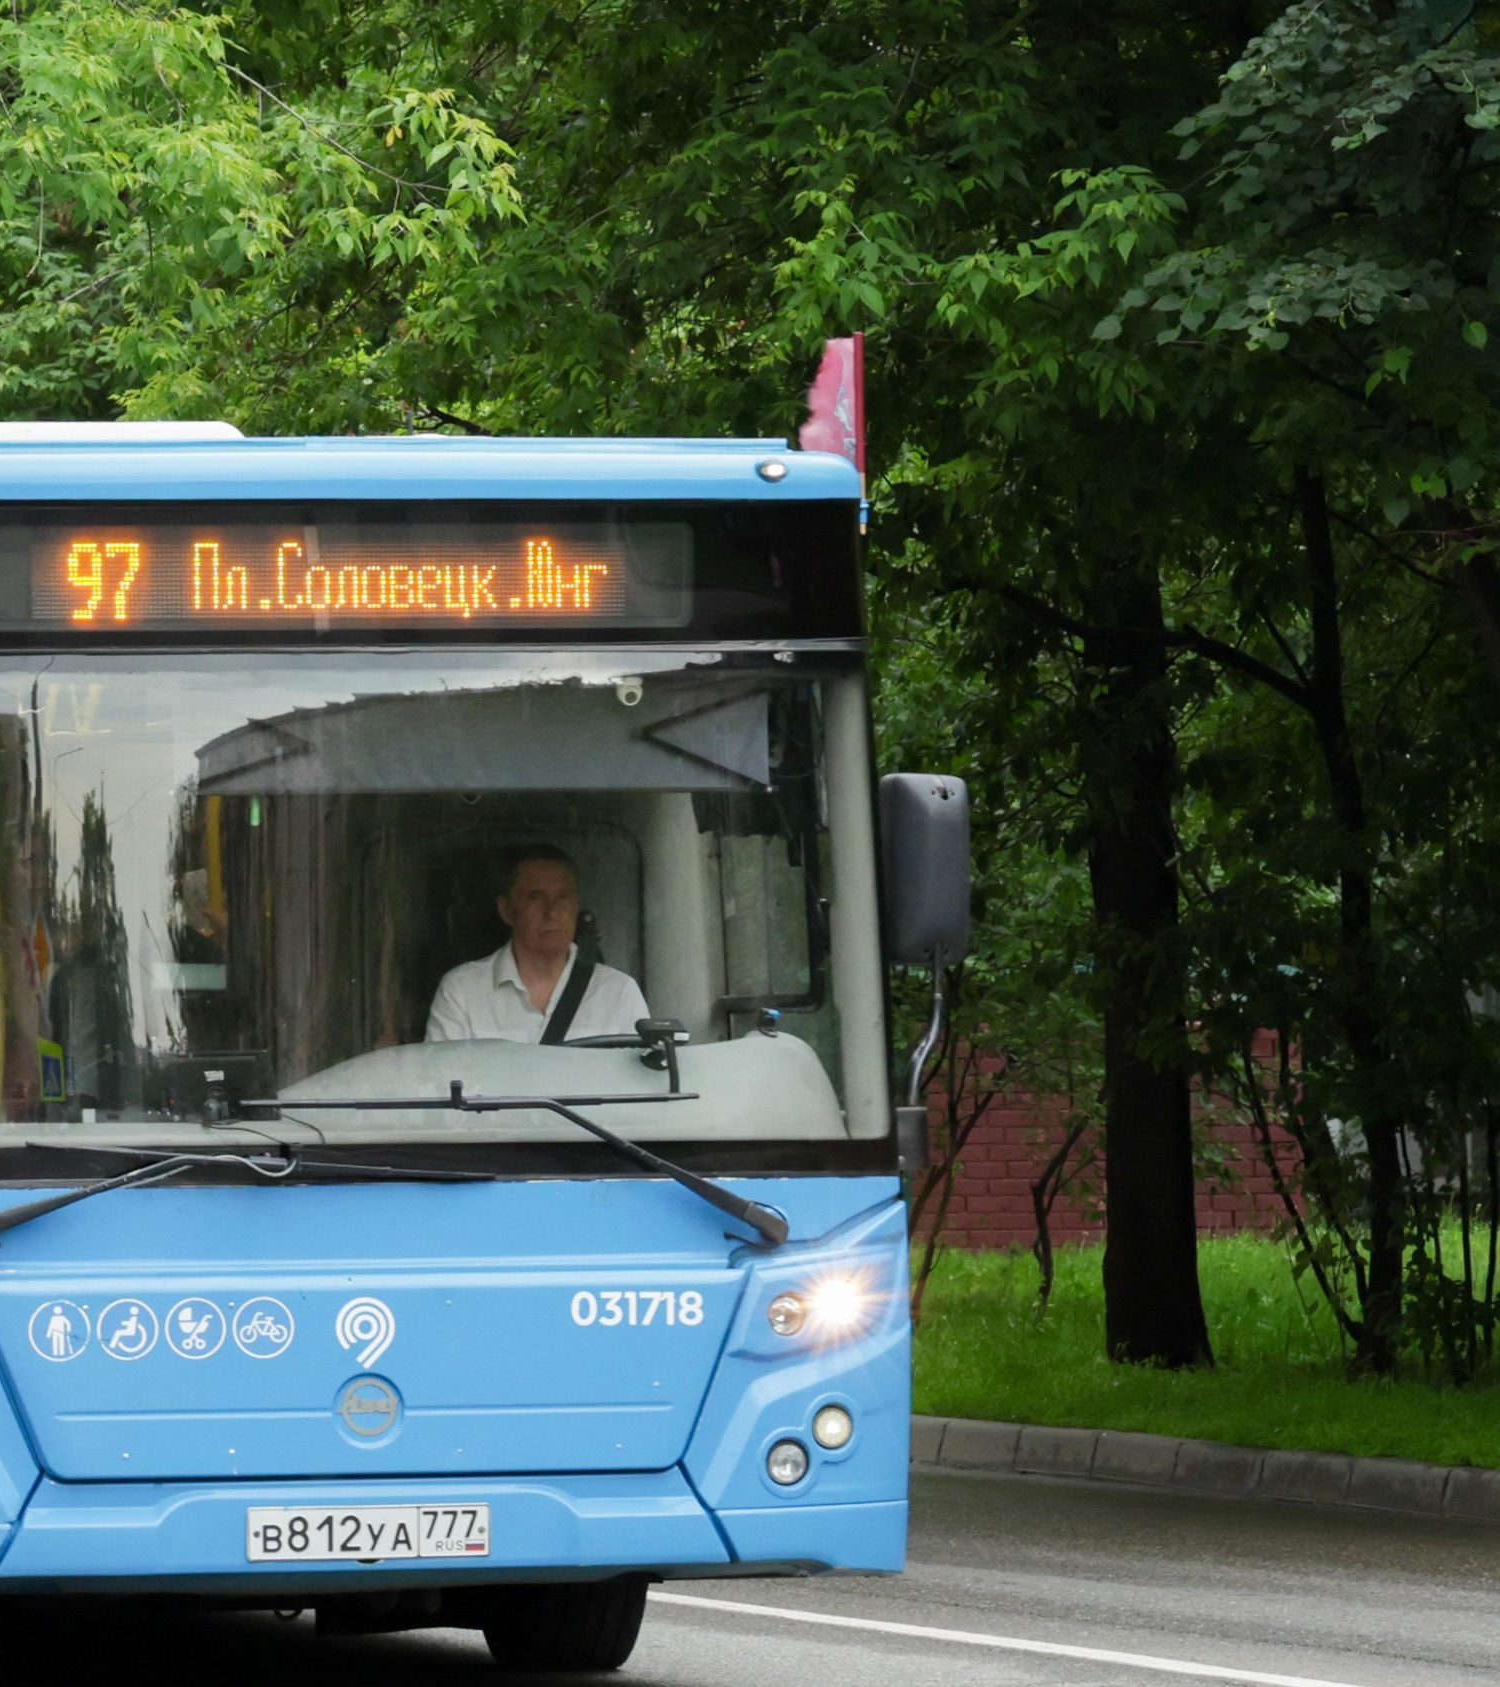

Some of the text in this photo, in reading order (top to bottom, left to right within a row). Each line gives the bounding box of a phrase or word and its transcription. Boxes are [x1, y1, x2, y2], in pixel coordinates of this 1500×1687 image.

[66, 541, 141, 620] 97
[570, 1290, 705, 1327] 031718
[422, 1509, 479, 1540] 777
[436, 1539, 465, 1552] RUS
